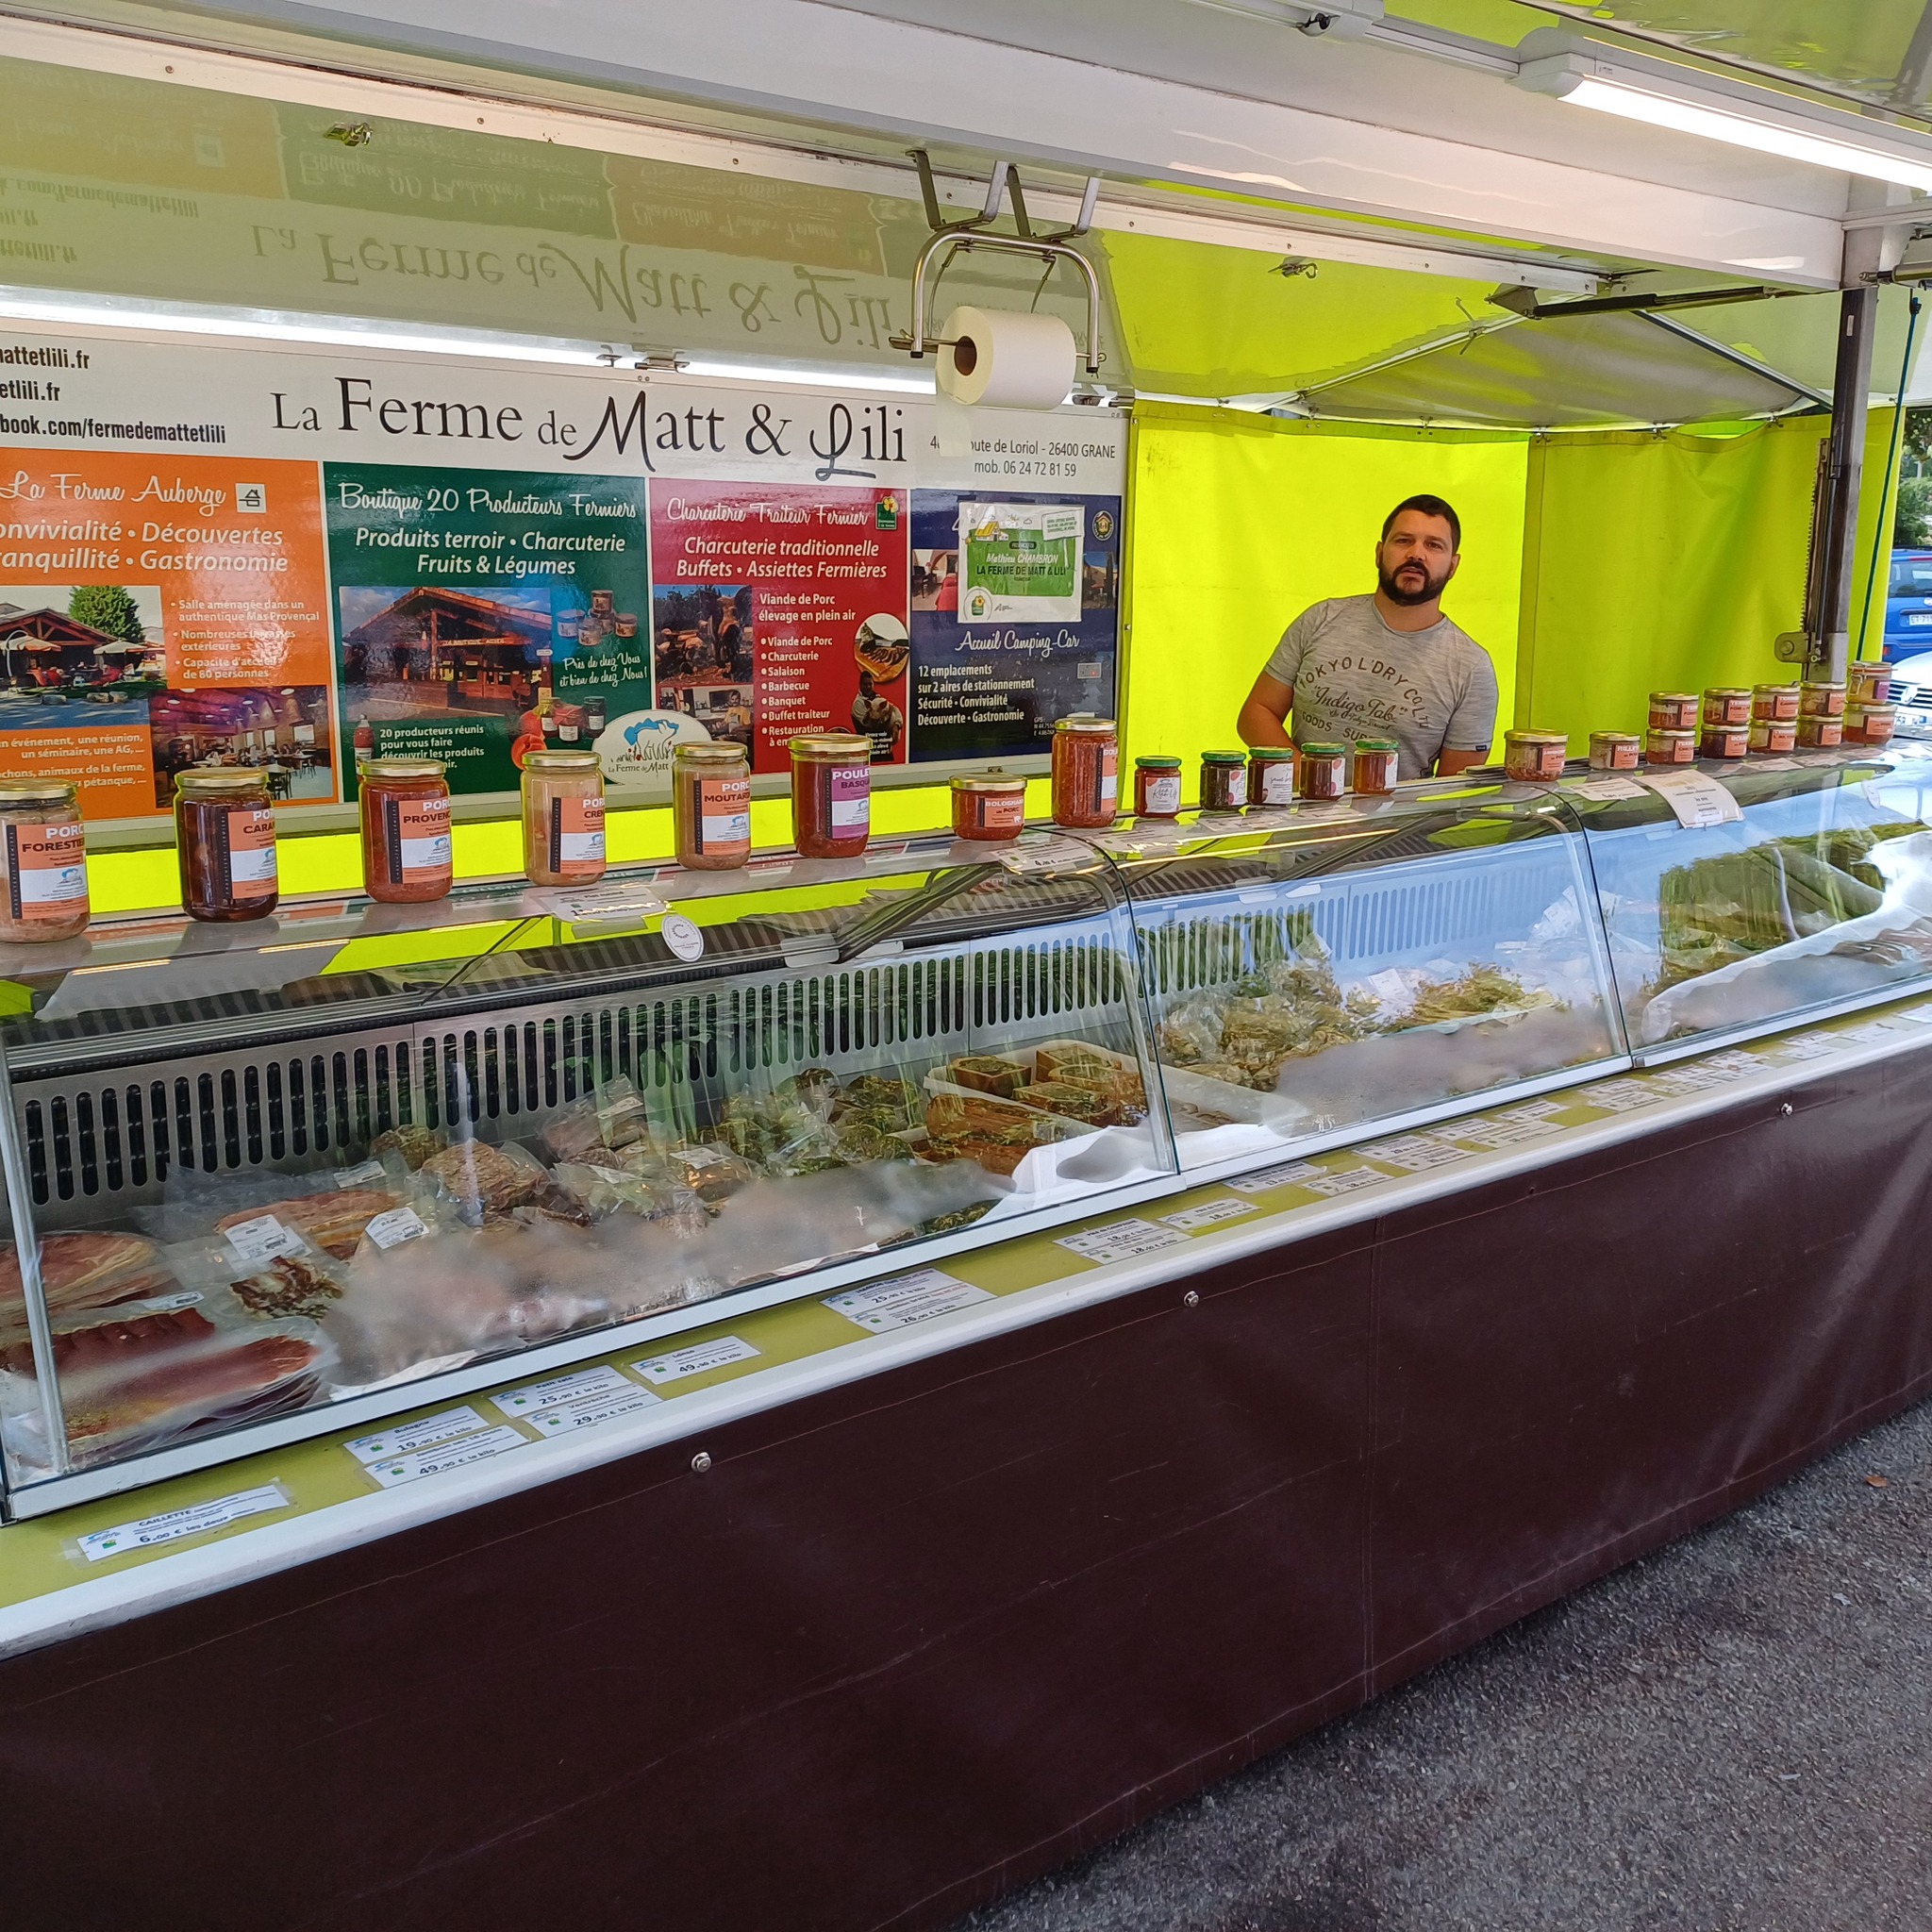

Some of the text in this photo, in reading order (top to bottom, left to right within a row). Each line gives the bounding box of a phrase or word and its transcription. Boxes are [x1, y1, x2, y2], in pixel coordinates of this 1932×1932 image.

[270, 376, 908, 481] La Ferme de Matt & Lili
[994, 440, 1116, 458] de Loriol 26400 GRANE
[974, 461, 1076, 476] mob. 06 24 72 81 59
[0, 471, 226, 517] La Ferme Auberge
[339, 483, 637, 519] Boutique 20 Producteurs Fermiers
[667, 498, 869, 525] Charcuterie Traiteur Fermier
[142, 522, 283, 545] Découvertes
[356, 527, 625, 553] Produits terroir Charcuterie
[684, 536, 879, 557] Charcuterie traditionnelle
[0, 548, 288, 574] anquillité Gastronomie
[417, 555, 576, 578] Fruits & Légumes
[676, 559, 888, 578] Buffets Assiettes Fermières
[976, 565, 987, 575] LA
[988, 565, 1014, 575] FERME
[1015, 565, 1025, 575] DE
[1027, 566, 1046, 575] MATT
[179, 599, 205, 609] Salle
[264, 600, 289, 609] dans
[291, 601, 304, 609] un
[759, 593, 835, 605] Viande de Porc
[179, 611, 320, 624] authentique Mas Provençal
[758, 609, 856, 624] élevage en plein air
[181, 629, 247, 639] Nombreuses
[955, 631, 1002, 651] Accueil
[181, 642, 242, 651] extérieures
[768, 637, 833, 646] Viande de Porc
[562, 652, 641, 672] Près de chez Vous
[768, 651, 819, 661] Charcuterie
[183, 658, 230, 669] Capacité
[183, 670, 269, 680] de personnes
[768, 666, 805, 676] Salaison
[918, 664, 992, 679] 12 emplacements
[559, 676, 569, 687] et
[589, 672, 599, 684] de
[600, 670, 620, 688] chez
[769, 681, 809, 691] Barbecue
[918, 678, 1035, 694] sur 2 aires de stationnement
[769, 696, 806, 708] Banquet
[918, 693, 1008, 710] Sécurité Convivialité
[769, 709, 830, 721] Buffet traiteur
[918, 709, 1024, 726] Découverte Gastronomie
[380, 724, 484, 740] 20 producteurs réunis
[769, 724, 824, 736] Restauration
[11, 738, 74, 747] événement,
[78, 736, 98, 744] une
[100, 733, 143, 743] réunion,
[380, 738, 453, 751] pour vous faire
[22, 750, 36, 758] un
[38, 747, 92, 758] séminaire,
[94, 746, 113, 756] une
[429, 747, 443, 758] les
[445, 746, 485, 758] produits
[39, 767, 84, 777] animaux
[86, 765, 99, 774] de
[101, 764, 111, 773] la
[644, 761, 669, 774] Matt
[84, 778, 136, 789] pétanque,
[139, 1510, 192, 1526] CAILLETTE
[204, 1516, 228, 1527] deux
